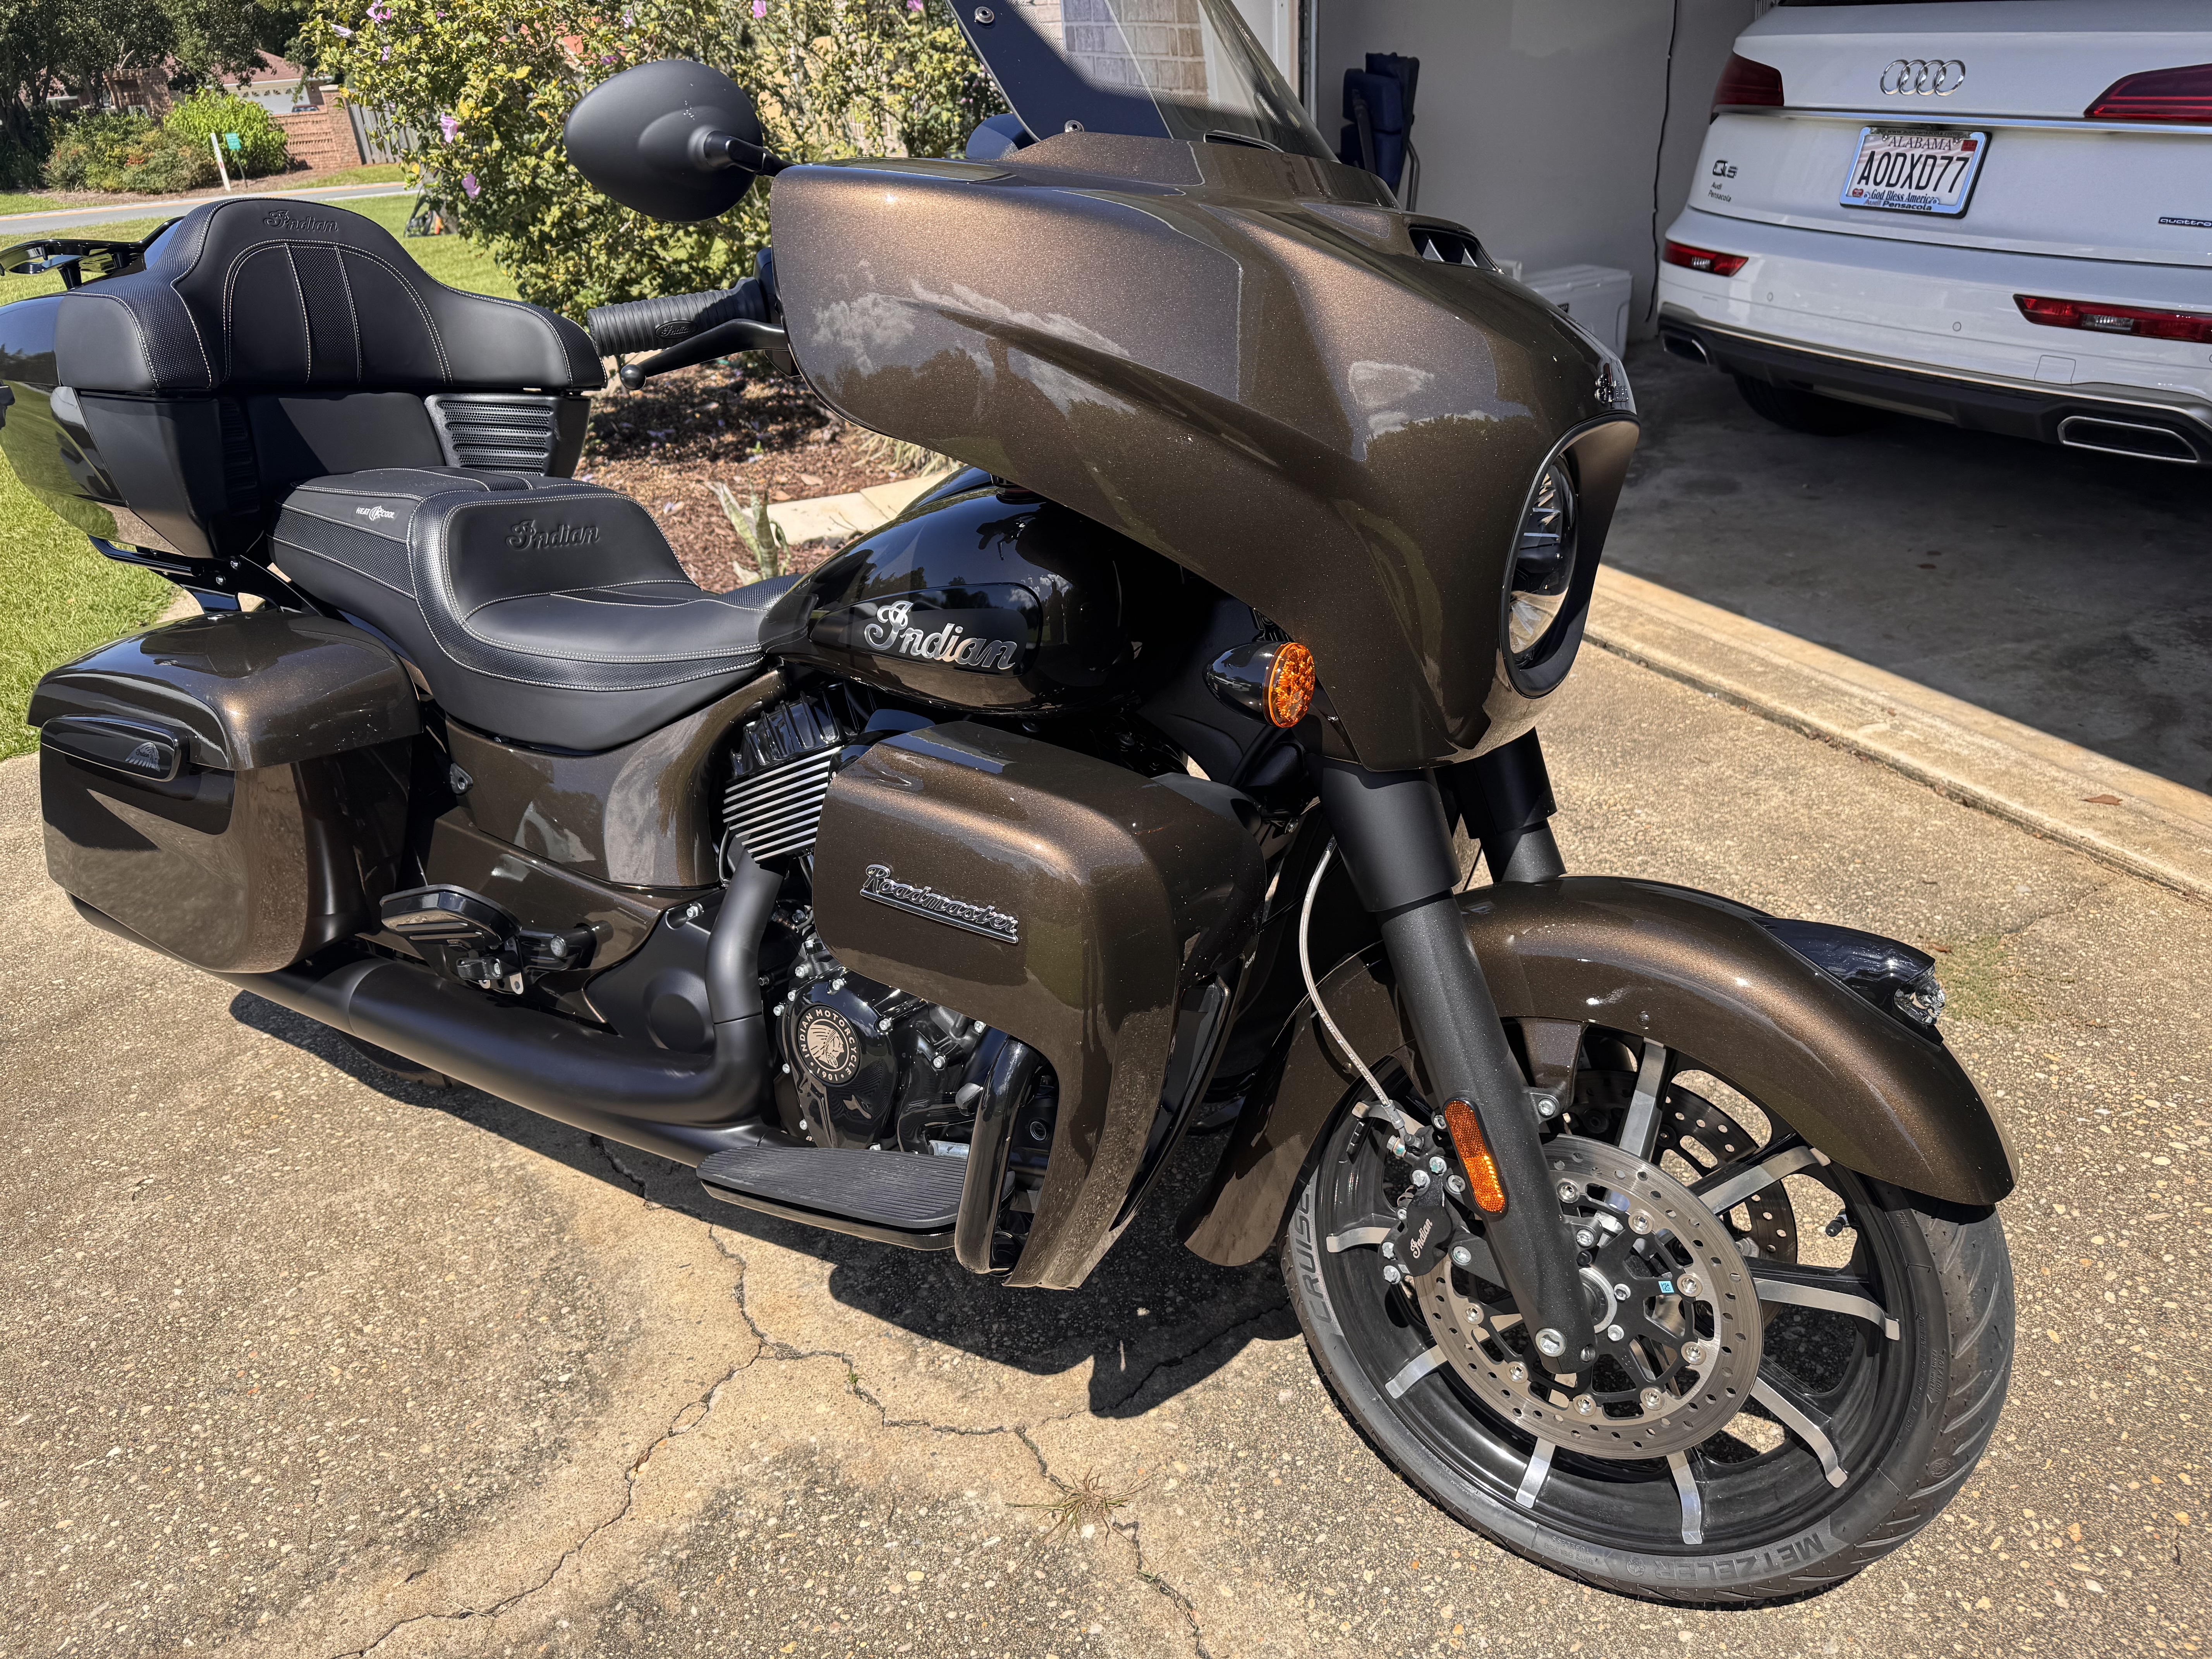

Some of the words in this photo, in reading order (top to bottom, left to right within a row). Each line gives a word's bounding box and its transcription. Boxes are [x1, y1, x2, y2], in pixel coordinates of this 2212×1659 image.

[1888, 136, 1951, 150] ALABAMA
[1712, 160, 1738, 179] Q5
[1857, 150, 1970, 193] A0DXD77
[1711, 181, 1723, 190] Audi
[1871, 189, 1886, 199] God
[1886, 190, 1905, 202] Bless
[1882, 201, 1932, 211] Pensacola
[264, 210, 338, 232] Indian
[356, 507, 371, 516] HEAT
[381, 510, 395, 519] COOL
[505, 520, 600, 551] Indian
[864, 600, 1017, 670] Indian
[862, 864, 1018, 933] Roadmaster
[800, 1013, 813, 1058] INDIAN
[816, 1009, 857, 1075] MOTORCYCLE
[817, 1068, 838, 1081] 1901
[1410, 1217, 1433, 1259] Indian
[1935, 1355, 1944, 1395] ROTATION
[1551, 1535, 1590, 1554] TUBELESS
[1654, 1532, 1828, 1581] METZELER
